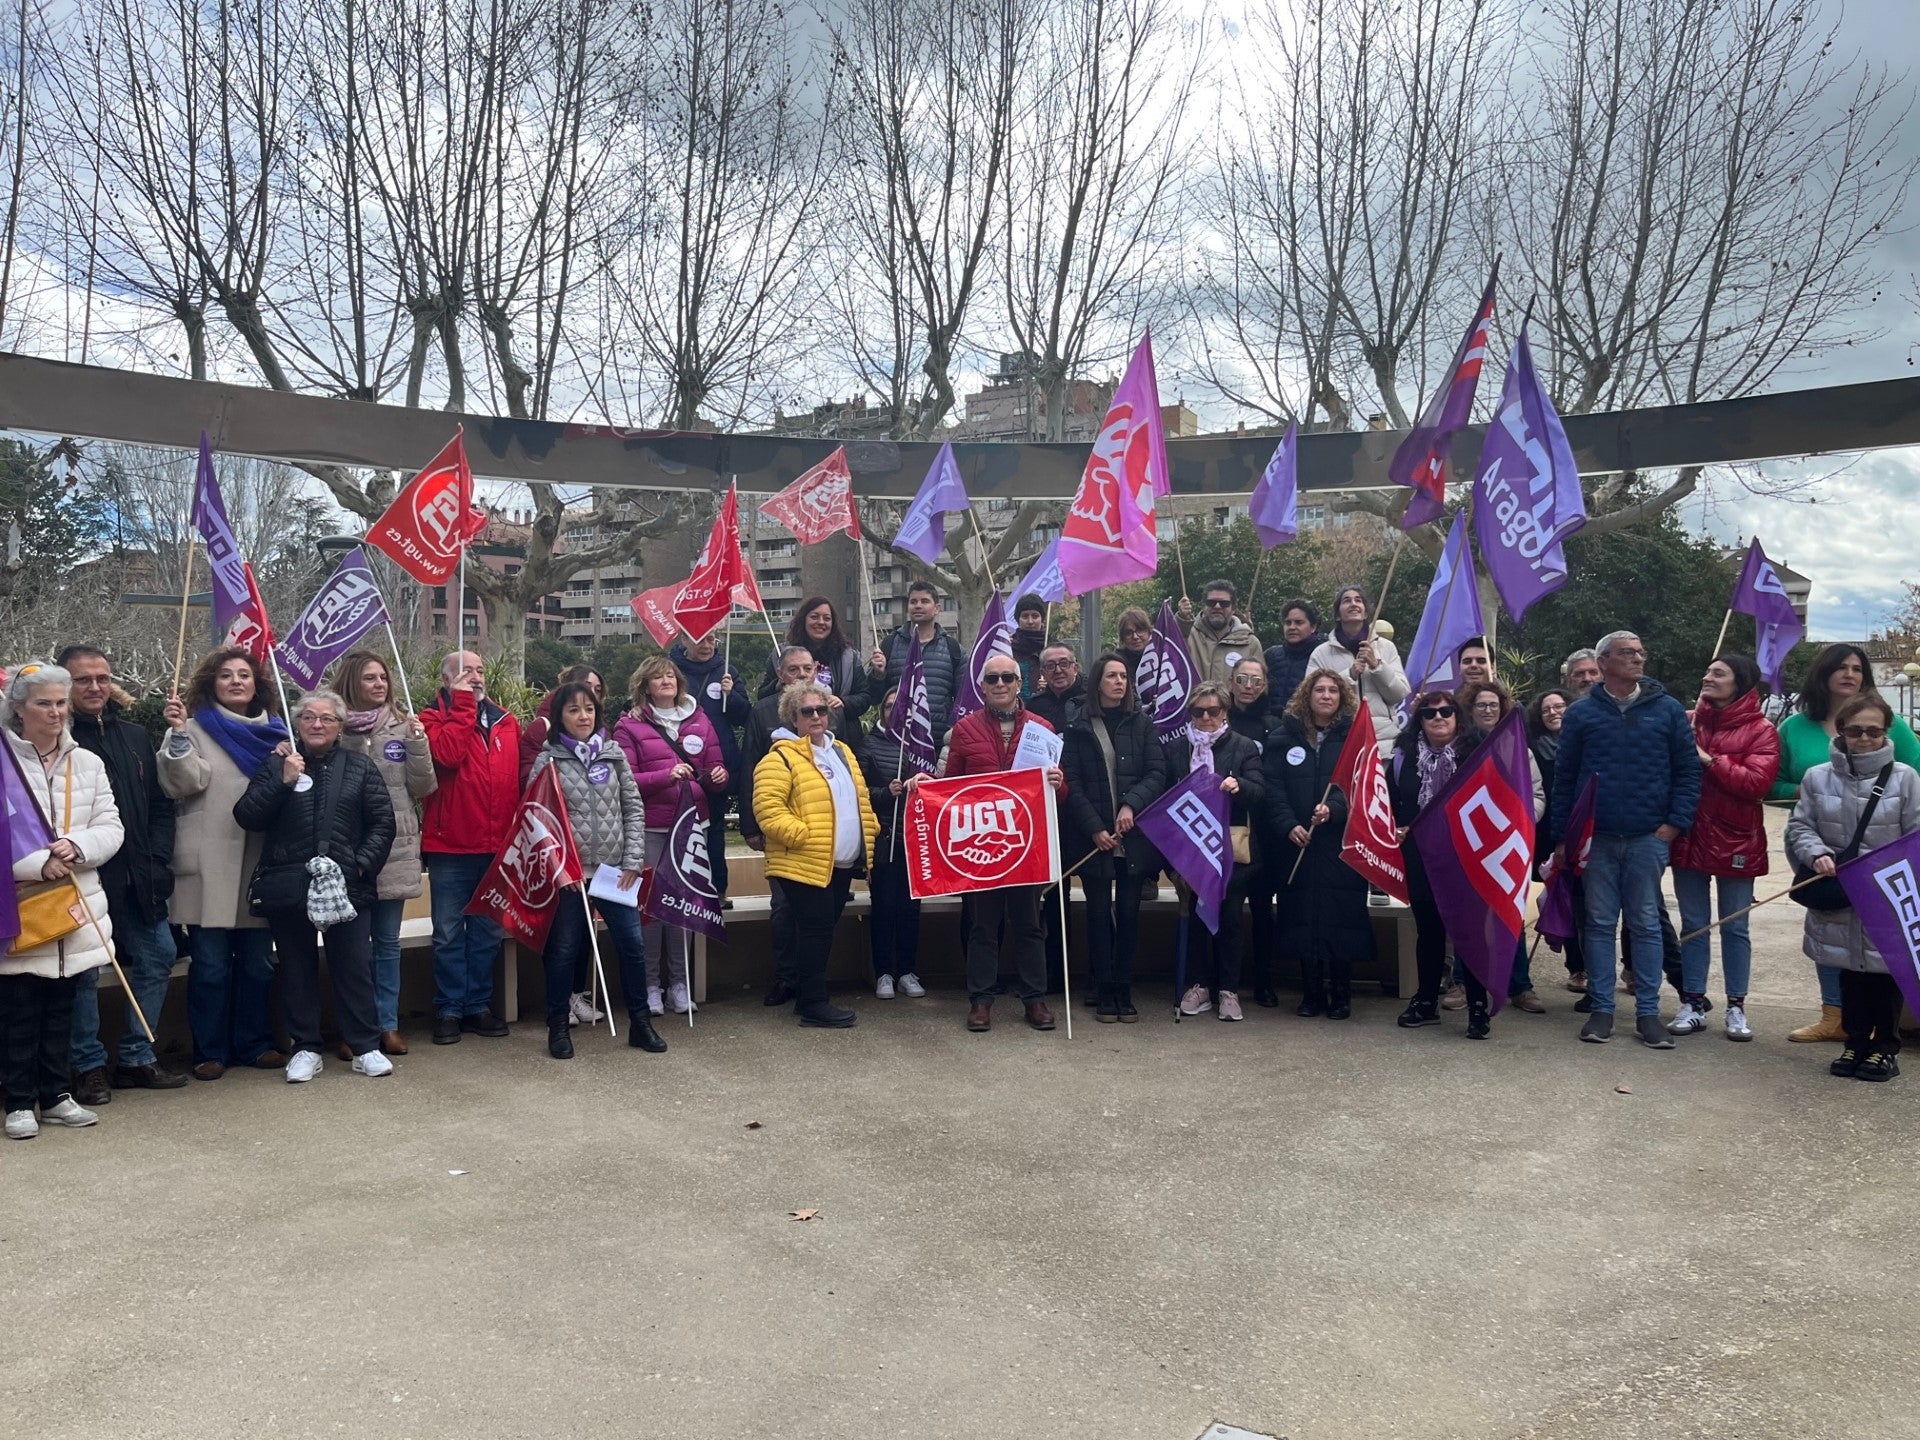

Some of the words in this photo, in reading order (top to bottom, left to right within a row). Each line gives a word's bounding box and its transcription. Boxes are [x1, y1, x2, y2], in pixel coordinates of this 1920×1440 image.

[914, 798, 932, 881] www.ugt.es
[951, 799, 1016, 839] UGT
[1176, 799, 1223, 861] CCO
[1885, 870, 1920, 966] CCO
